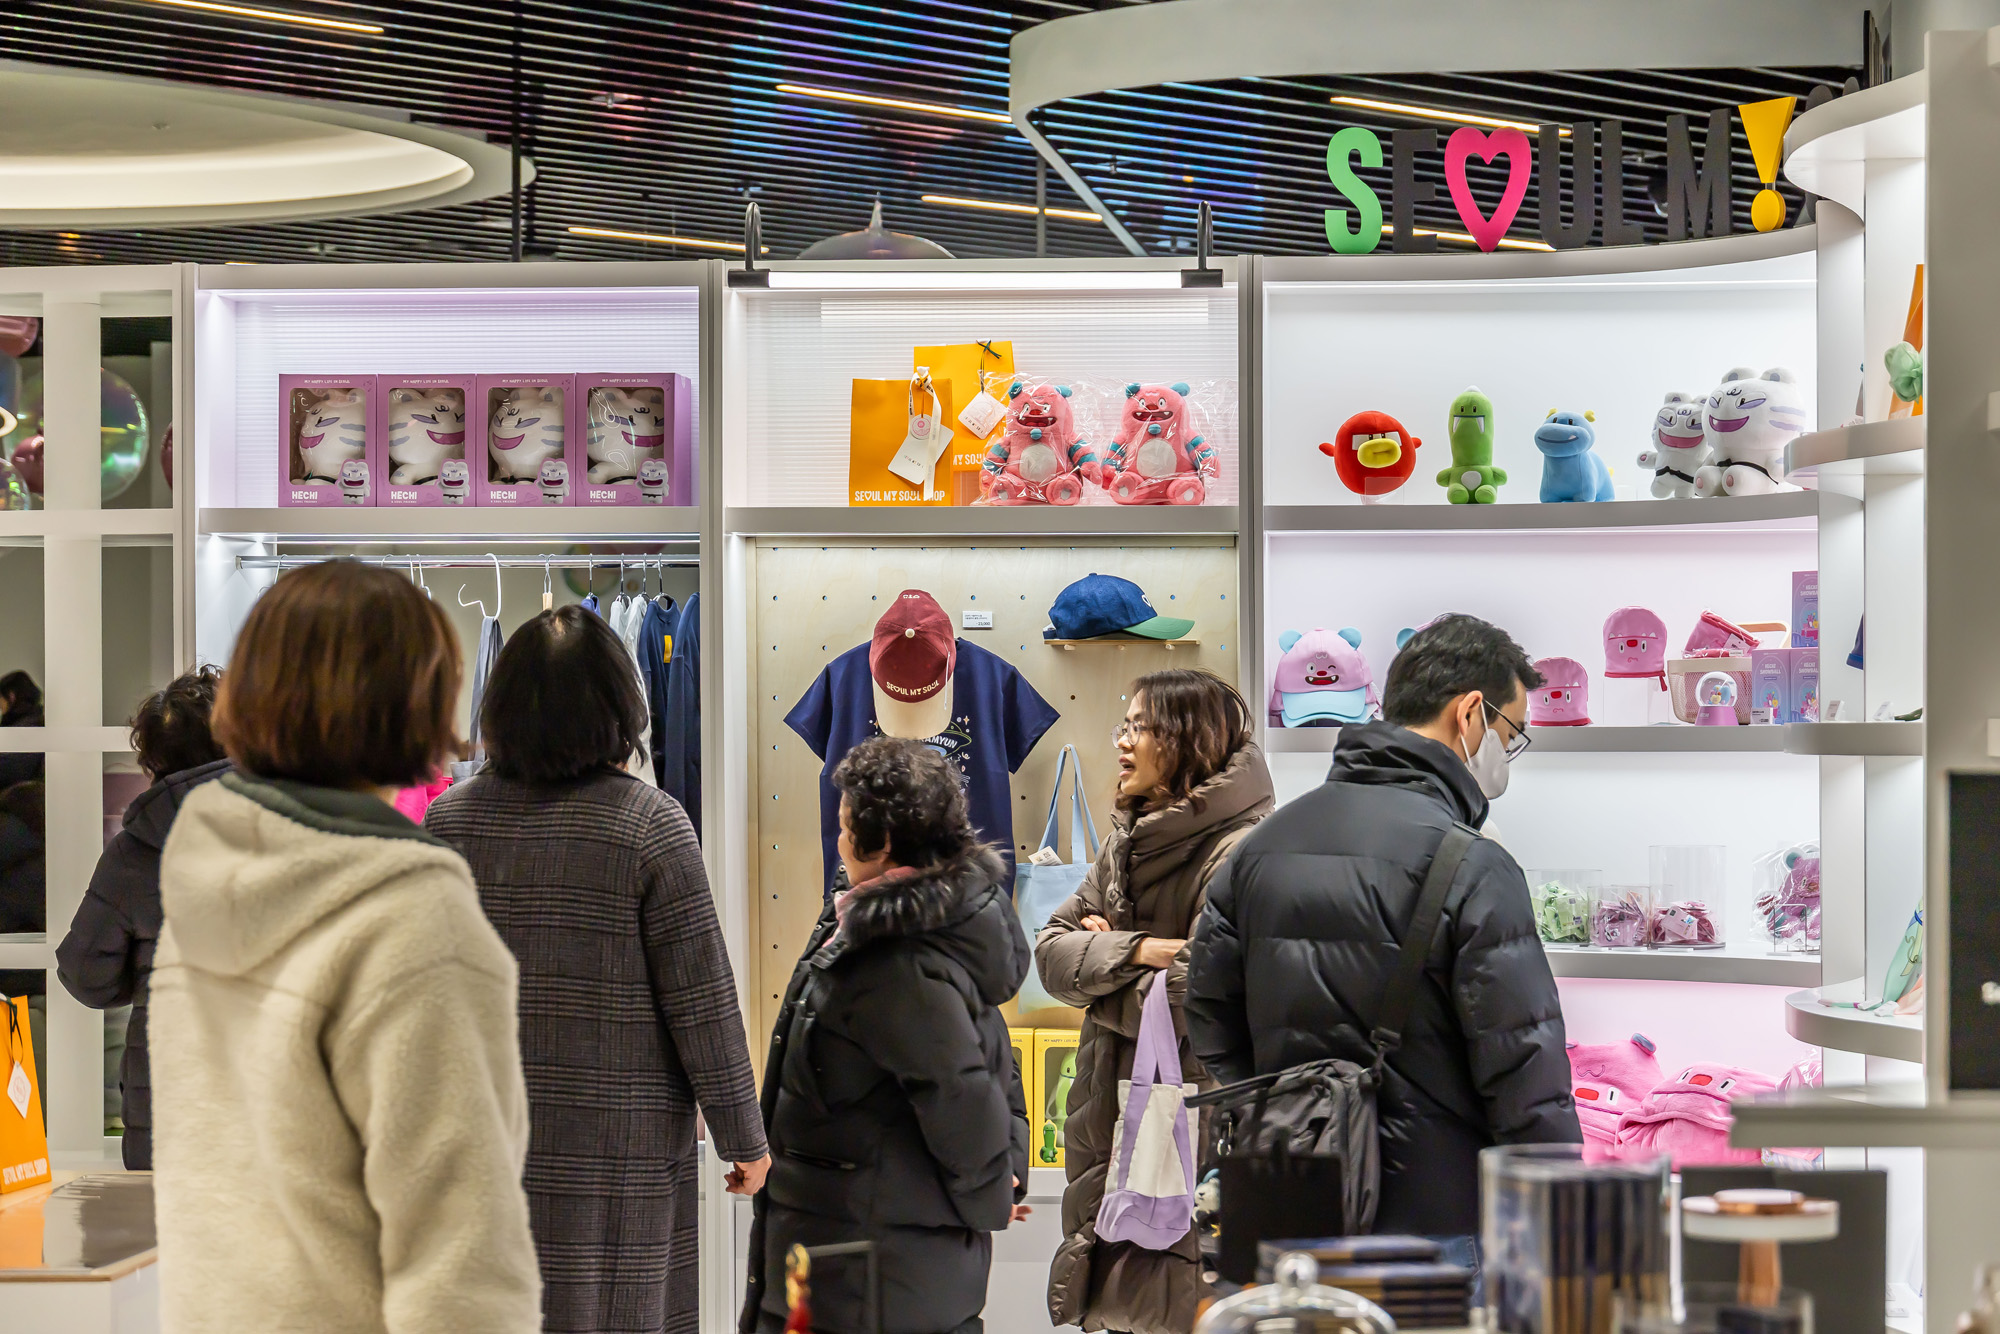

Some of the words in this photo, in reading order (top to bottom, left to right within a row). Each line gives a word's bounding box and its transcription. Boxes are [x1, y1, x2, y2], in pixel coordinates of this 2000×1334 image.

[965, 453, 984, 465] SOU
[291, 490, 318, 500] HECHI
[390, 490, 417, 500] HECHI
[490, 490, 517, 500] HECHI
[589, 490, 617, 499] HECHI
[899, 490, 920, 501] SOUL
[922, 680, 940, 694] SOUL
[922, 735, 958, 749] AMYUN
